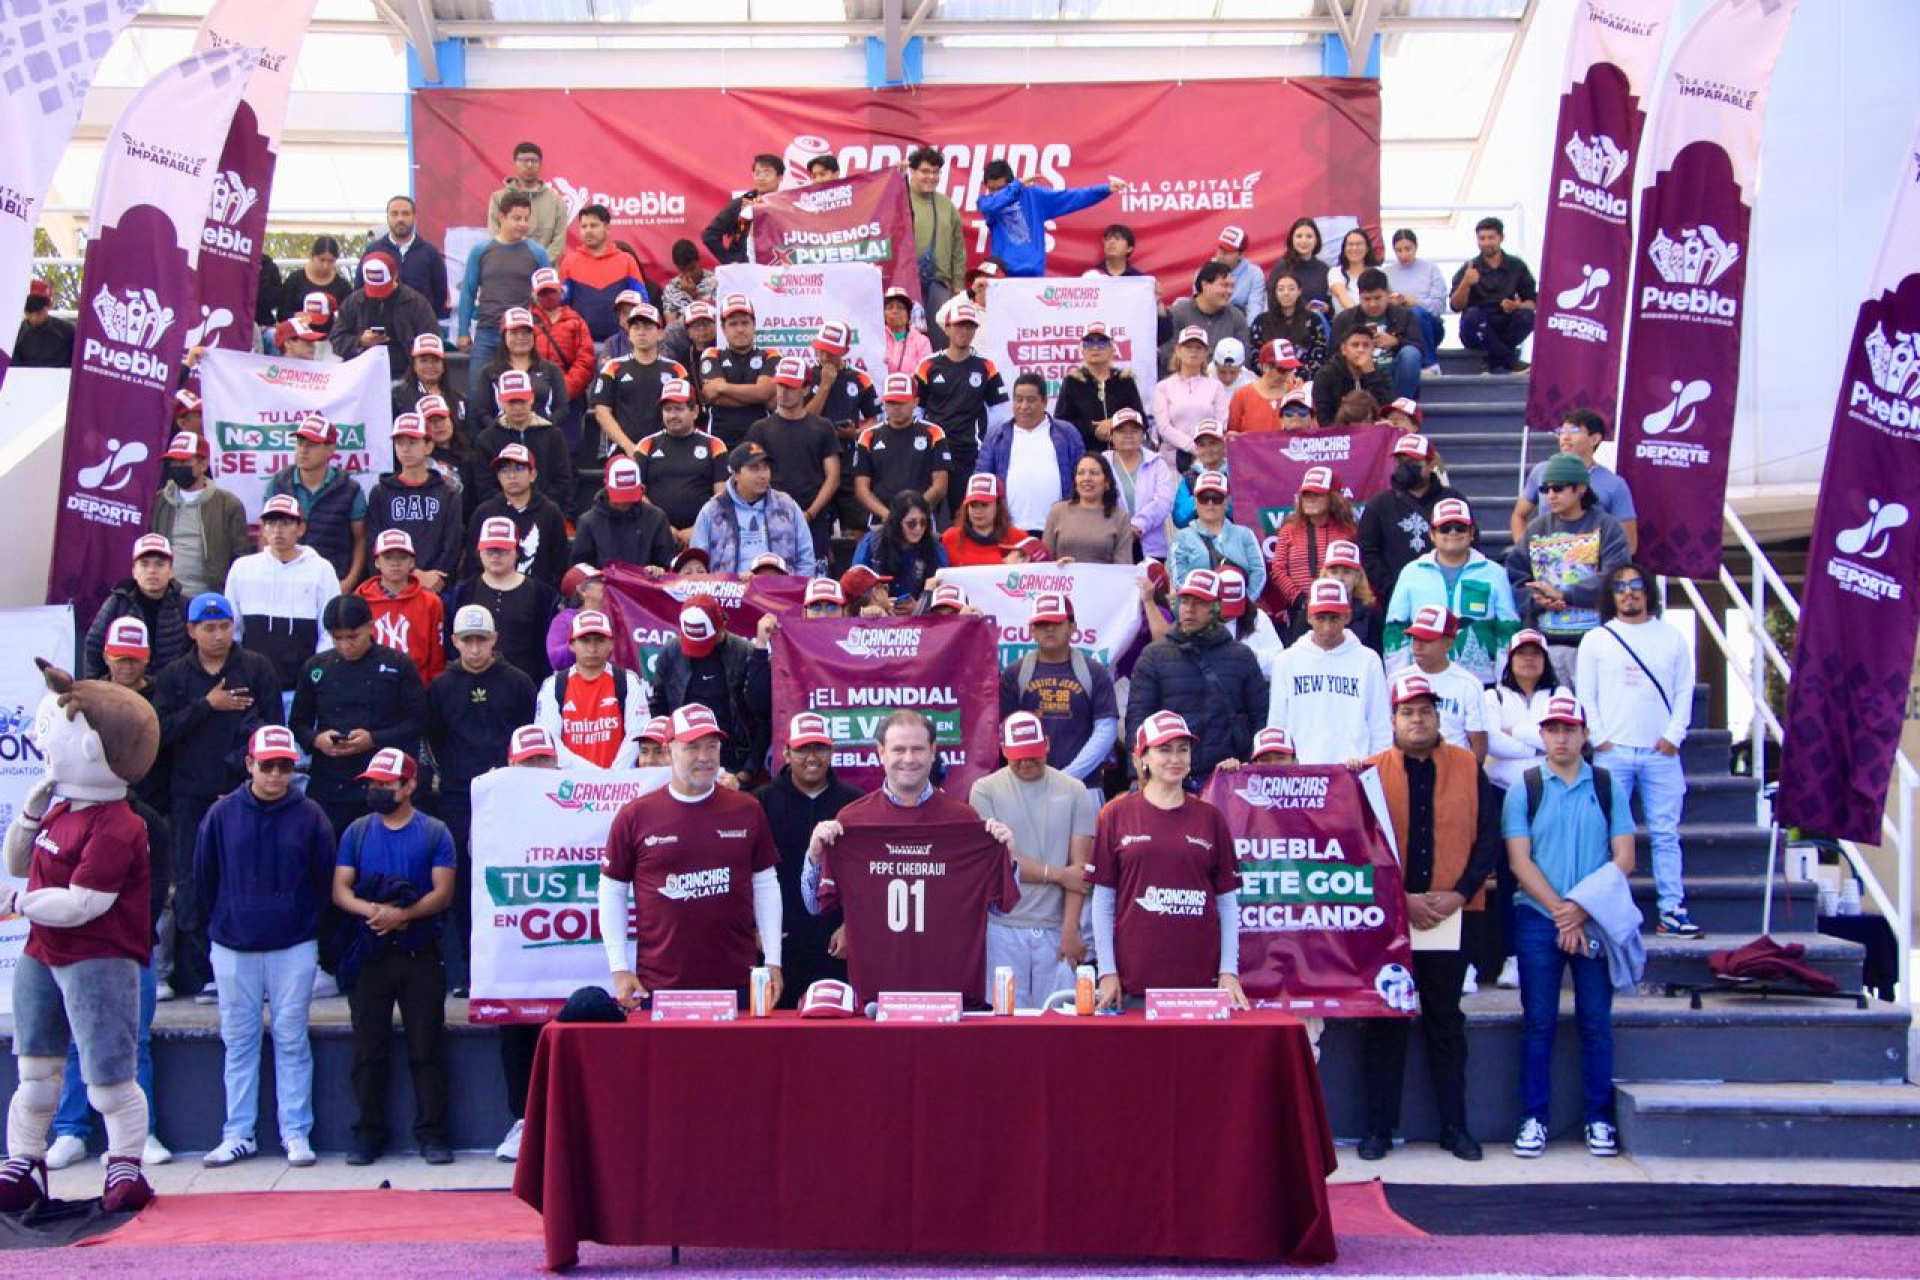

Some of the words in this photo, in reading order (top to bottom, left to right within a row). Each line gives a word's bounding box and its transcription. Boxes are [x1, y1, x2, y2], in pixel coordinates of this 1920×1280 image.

[1589, 12, 1651, 36] IMPARABLE
[1680, 85, 1752, 111] IMPARABLE
[127, 146, 201, 177] IMPARABLE
[1130, 181, 1151, 193] LA
[1161, 179, 1243, 193] CAPITAL
[592, 191, 685, 216] Puebla
[1121, 192, 1254, 212] IMPARABLE
[1559, 179, 1627, 217] Puebla
[203, 225, 252, 255] ebla
[784, 222, 881, 247] ¡JUGUEMOS
[797, 241, 887, 266] PUEBLA!
[1641, 286, 1737, 317] Puebla
[763, 316, 824, 328] APLASTA
[1017, 327, 1039, 340] ¡EN
[1042, 325, 1084, 337] PUEB
[84, 338, 169, 382] Puebla
[1018, 343, 1084, 361] SIENT
[258, 411, 280, 423] TU
[1301, 436, 1350, 452] CANCHAS
[1635, 443, 1710, 464] DEPORTE
[215, 452, 256, 480] ¡SE
[66, 495, 142, 525] DEPORTE
[391, 495, 440, 521] GAP
[687, 580, 745, 598] CANCHAS
[1019, 574, 1075, 592] CANCHAS
[1827, 560, 1902, 600] DEPORTE
[861, 627, 922, 646] CANCHAS
[1294, 675, 1324, 696] NEW
[1326, 675, 1360, 697] YORK
[809, 688, 843, 709] ¡EL
[848, 686, 958, 706] MUNDIAL
[563, 716, 618, 733] Emirates
[937, 721, 954, 732] EN
[831, 752, 880, 768] EBLA
[573, 782, 640, 800] CANCHAS
[1262, 776, 1330, 797] CANCHAS
[1284, 797, 1325, 809] LATAS
[1235, 838, 1345, 860] PUEBLA
[677, 867, 730, 890] CANCHAS
[869, 861, 894, 875] PEPE
[896, 862, 946, 876] CHEDRAUI
[501, 872, 567, 898] TUS
[697, 884, 730, 899] LATAS
[1236, 870, 1299, 895] ETE
[1306, 871, 1373, 895] GOL
[887, 878, 925, 932] 01
[1157, 888, 1207, 906] CANCHAS
[494, 914, 517, 927] EN
[1237, 905, 1386, 928] ECICLANDO
